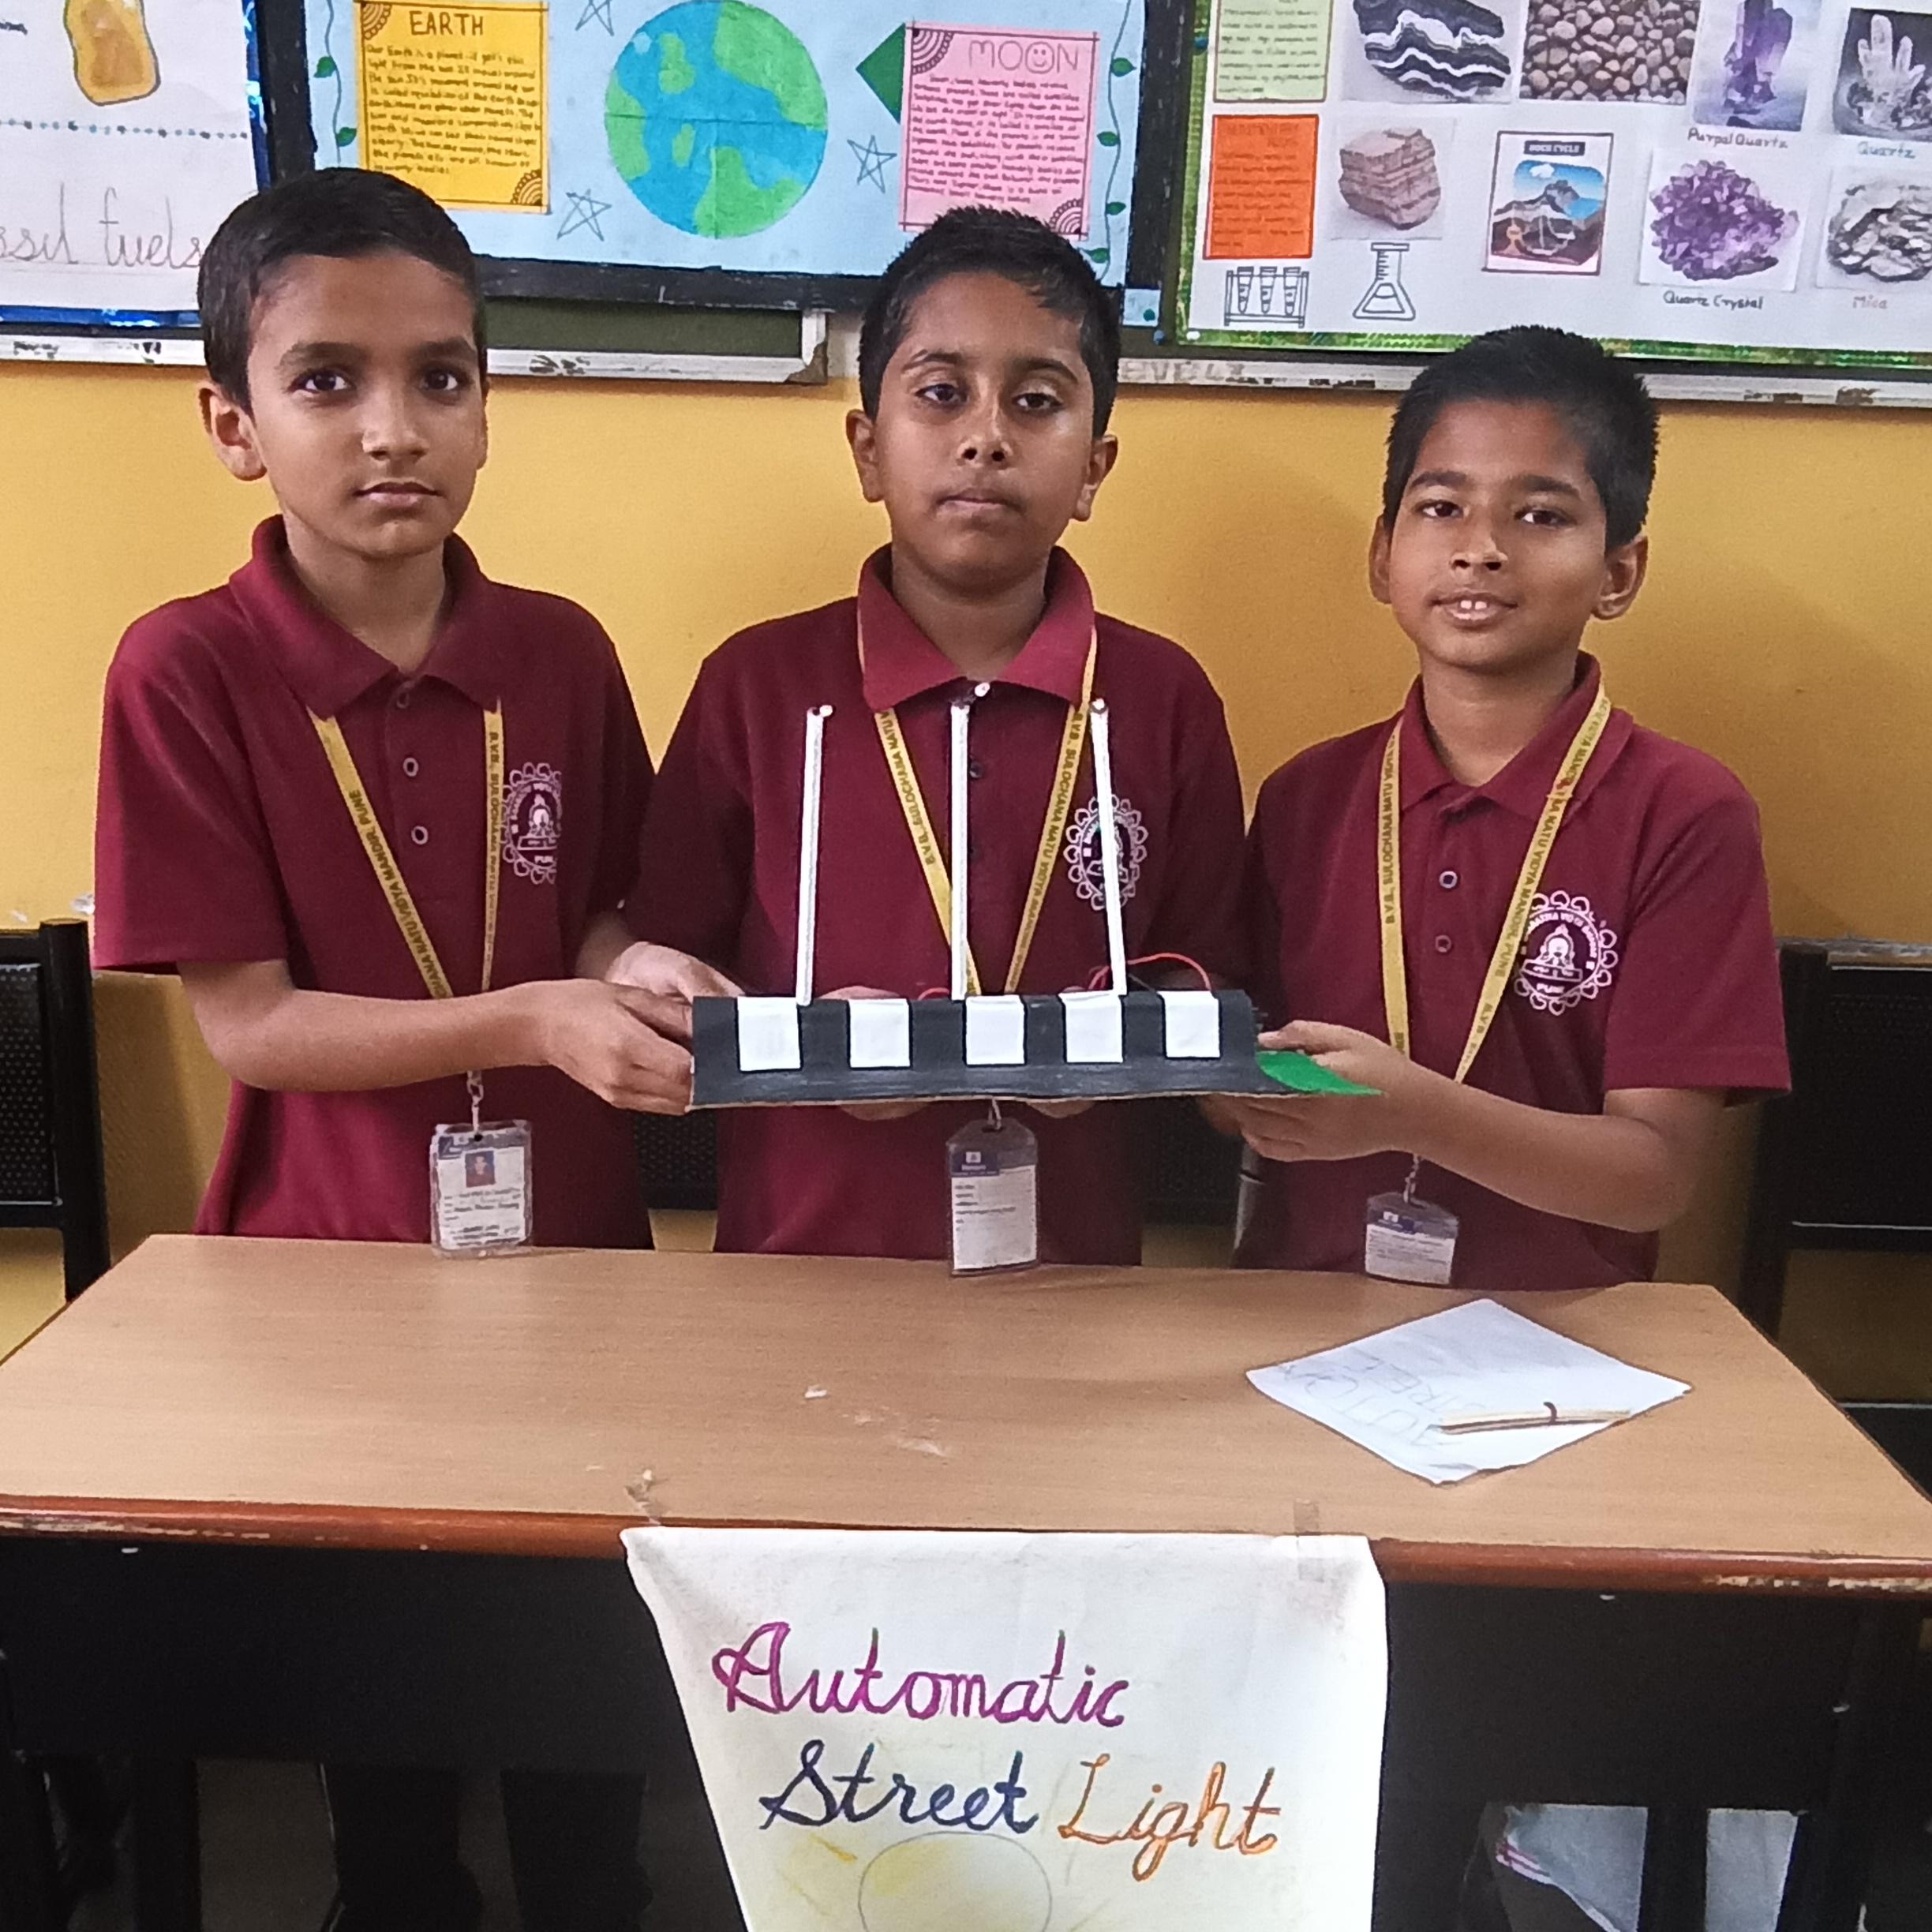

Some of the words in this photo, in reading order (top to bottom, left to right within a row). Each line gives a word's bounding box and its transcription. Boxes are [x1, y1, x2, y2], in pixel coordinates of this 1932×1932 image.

[409, 10, 484, 36] EARTH
[968, 39, 1080, 74] MOON
[1735, 133, 1789, 149] Quartz
[1856, 140, 1916, 159] Quartz
[1662, 290, 1710, 308] Quartz
[1713, 294, 1765, 311] Crystal
[1852, 294, 1889, 310] Mica
[880, 718, 900, 751] NATU
[348, 789, 373, 826] PUNE
[1537, 815, 1558, 848] NATU
[1525, 849, 1545, 886] VIDYA
[711, 1621, 1130, 1727] Automatic
[758, 1739, 1040, 1834] Street
[1058, 1753, 1282, 1881] Light
